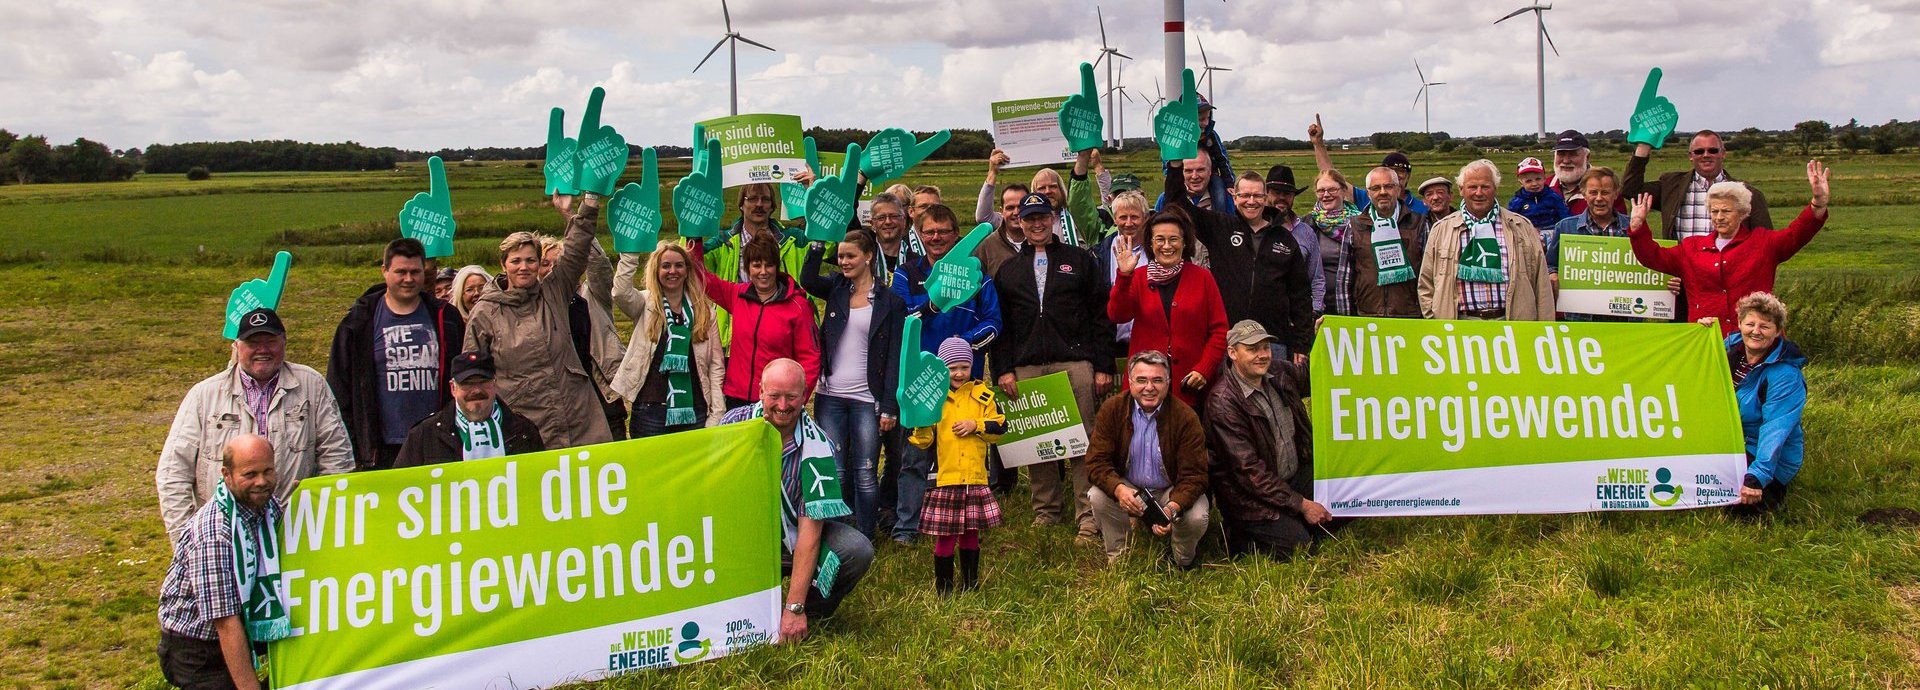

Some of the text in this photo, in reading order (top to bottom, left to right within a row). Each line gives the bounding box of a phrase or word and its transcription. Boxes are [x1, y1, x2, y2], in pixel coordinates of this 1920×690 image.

[1069, 106, 1098, 121] ENERGIE
[1163, 112, 1195, 131] ENERGIE
[726, 125, 752, 141] sind
[756, 123, 775, 138] die
[1070, 128, 1088, 139] HAND
[1162, 134, 1182, 148] HAND
[576, 136, 612, 162] ENERGIE
[870, 145, 881, 167] HAND
[890, 136, 904, 170] ENERGIE
[547, 146, 574, 172] ENERGIE
[593, 161, 617, 179] HAND
[819, 162, 837, 178] ind
[684, 185, 719, 207] ENERGIE
[819, 188, 850, 213] ENERGIE
[411, 206, 448, 226] ENERGIE
[619, 196, 655, 221] ENERGIE
[680, 209, 703, 226] HAND
[810, 210, 833, 229] HAND
[614, 221, 639, 240] HAND
[1564, 246, 1588, 263] Wir
[1591, 247, 1620, 265] sind
[939, 262, 969, 277] ENERGIE
[1563, 265, 1664, 286] Energiewende!
[941, 286, 961, 300] HAND
[383, 325, 413, 346] WE
[1323, 323, 1605, 376] Wir sind die
[905, 365, 935, 399] ENERGIE
[917, 371, 947, 403] BÜRGER-
[925, 387, 944, 411] HAND
[1030, 390, 1048, 407] die
[1330, 381, 1683, 452] Energiewende!
[1607, 468, 1649, 484] WENDE
[1695, 474, 1722, 485] 100%.
[284, 478, 379, 555] Wir
[398, 461, 519, 540] sind
[541, 451, 628, 523] die
[1331, 497, 1461, 509] www.die-buergerenergiewende.de
[1609, 501, 1649, 509] BÜRGERHAND
[282, 516, 715, 638] Energiewende!
[623, 627, 674, 651] WENDE
[726, 618, 756, 634] 100%.
